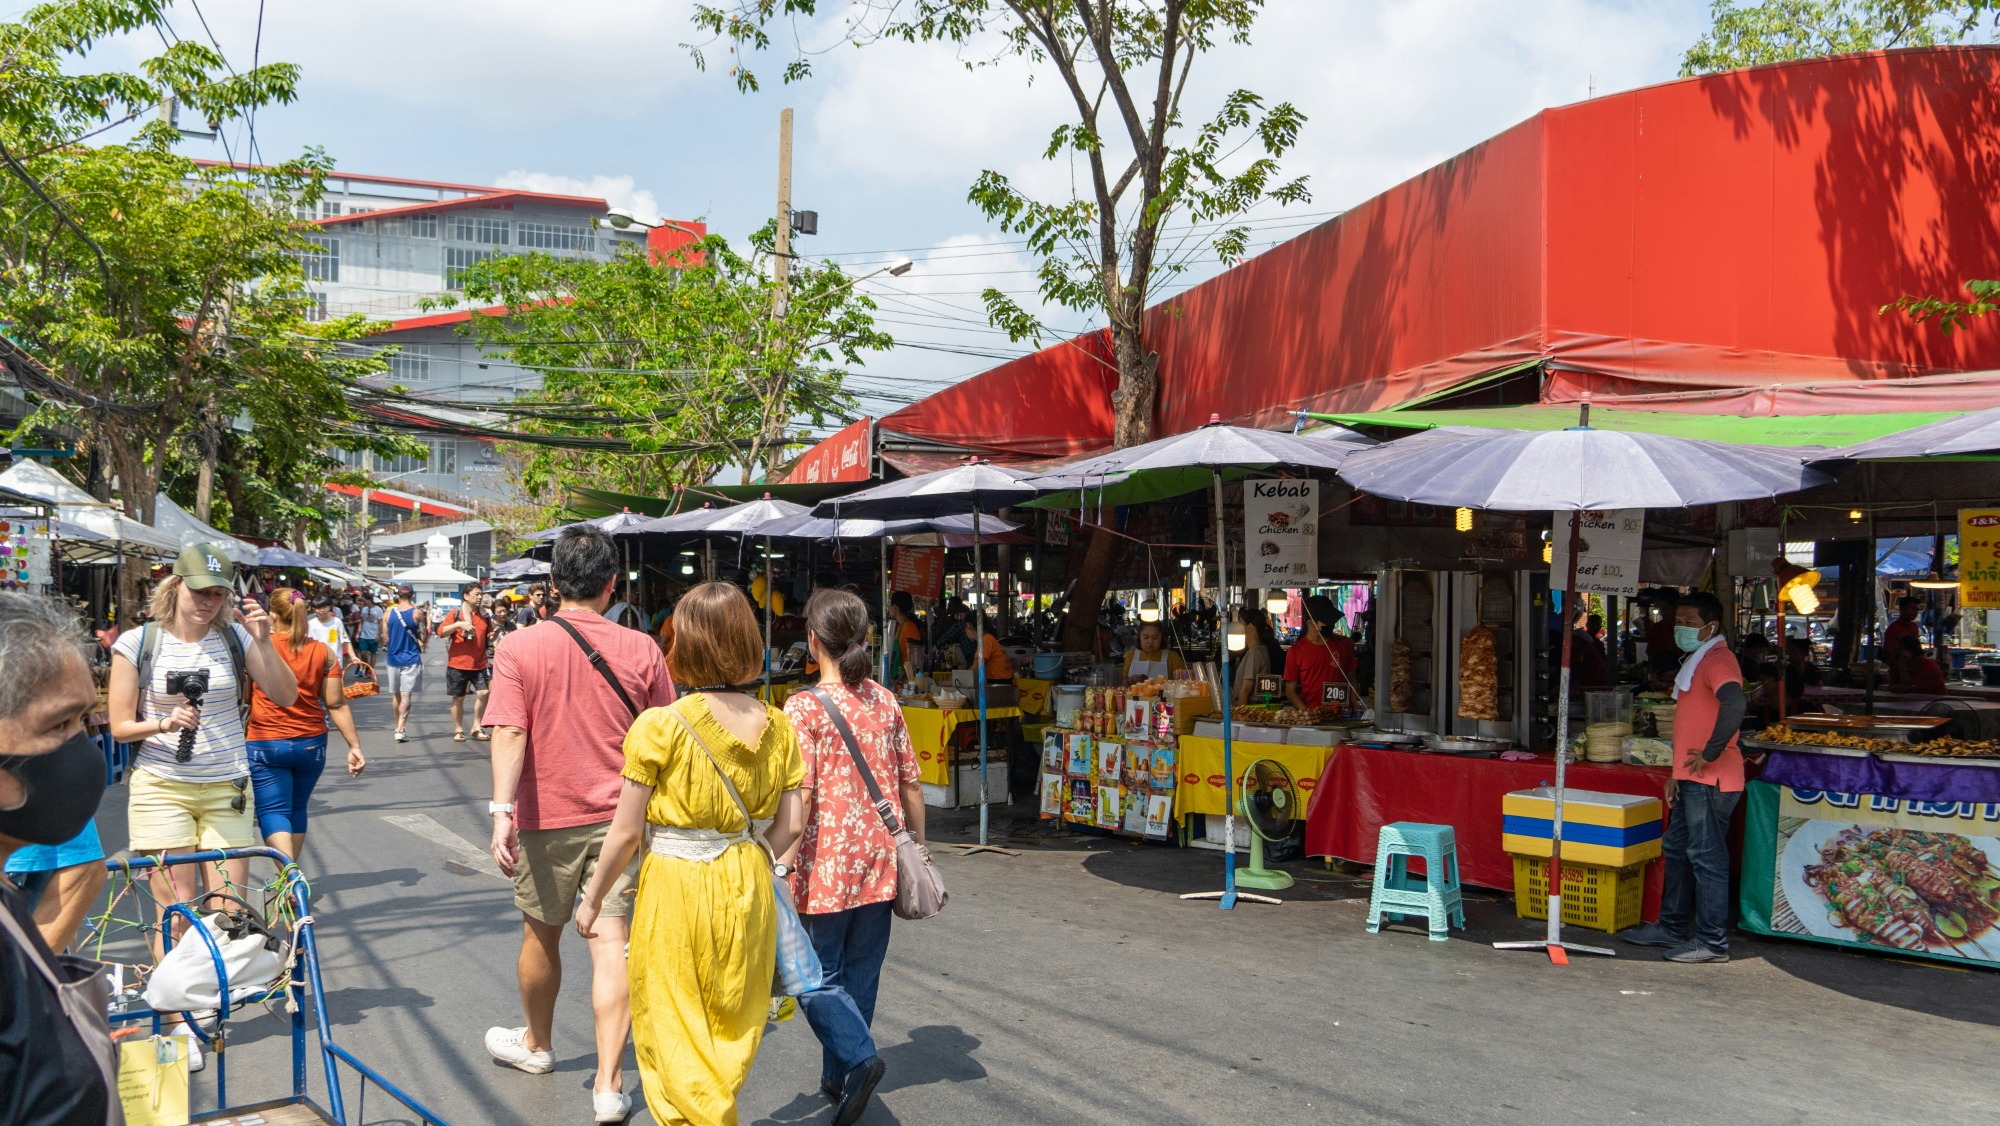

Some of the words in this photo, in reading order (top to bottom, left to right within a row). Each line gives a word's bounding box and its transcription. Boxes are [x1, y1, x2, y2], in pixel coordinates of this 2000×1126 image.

[1254, 481, 1310, 498] Kebab
[1971, 517, 1998, 525] J&K
[1259, 525, 1299, 534] Chicken
[207, 555, 221, 571] LA
[1264, 563, 1290, 574] Beef
[1576, 564, 1599, 575] eef
[1967, 561, 2000, 581] น้ำจิ้
[1591, 584, 1620, 592] Cheese
[1542, 865, 1584, 883] 09545929
